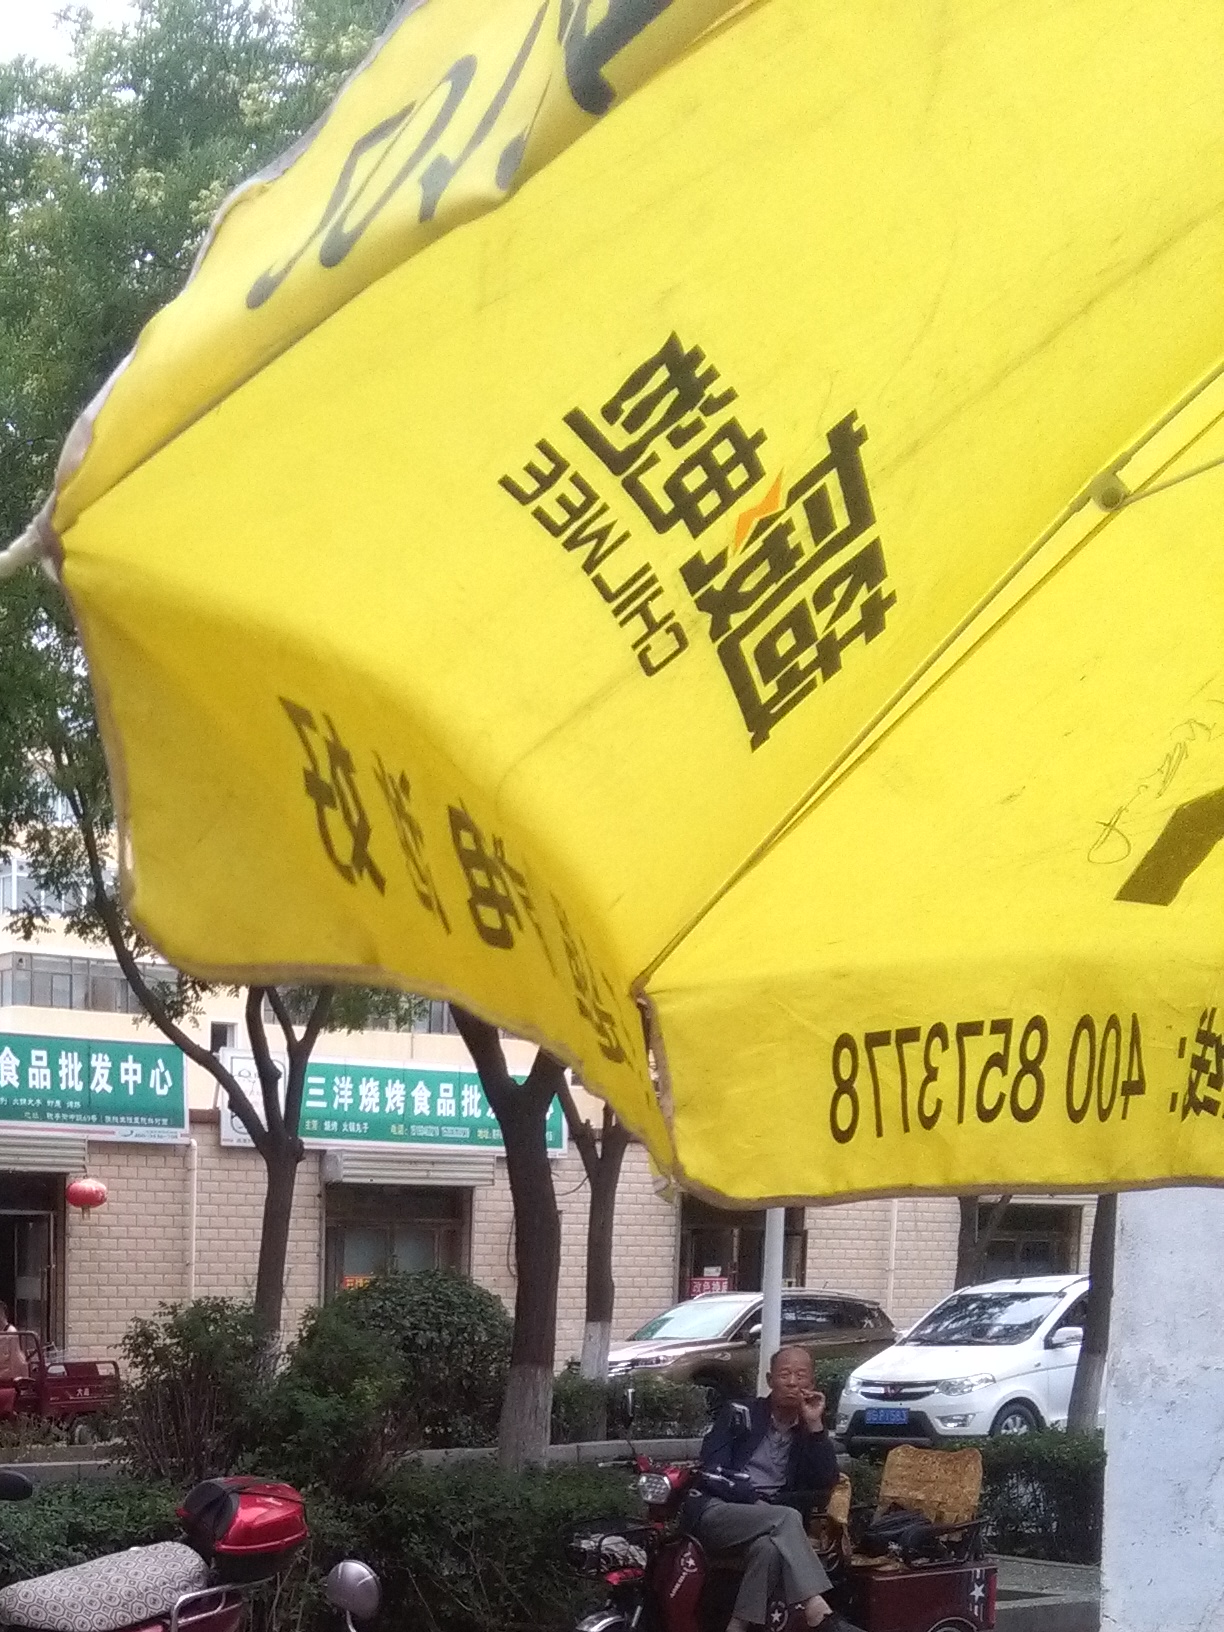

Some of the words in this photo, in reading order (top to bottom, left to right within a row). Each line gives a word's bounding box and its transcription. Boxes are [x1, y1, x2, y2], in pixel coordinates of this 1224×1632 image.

[305, 1075, 554, 1122] 三洋烧烤食品批
